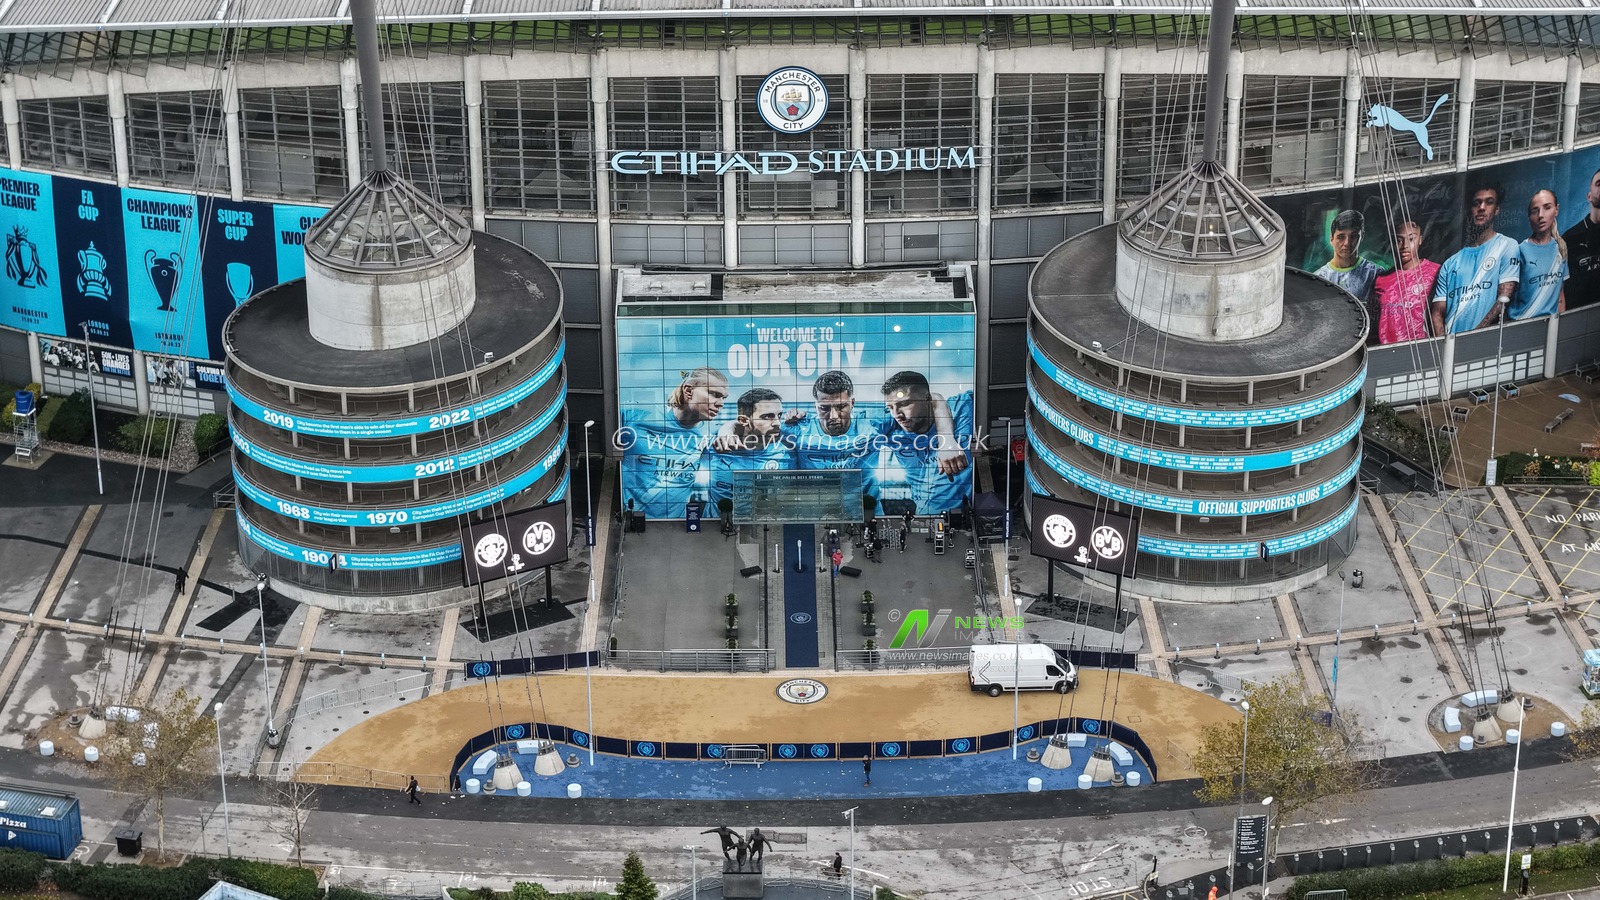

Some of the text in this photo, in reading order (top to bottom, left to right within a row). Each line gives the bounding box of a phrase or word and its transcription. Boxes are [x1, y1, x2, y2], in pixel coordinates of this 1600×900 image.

[765, 72, 820, 92] MANCHESTER
[610, 146, 976, 175] ETIHAD STADIUM
[0, 177, 40, 196] REMIER
[1, 192, 36, 212] LEAGUE
[82, 189, 94, 205] FA
[78, 204, 98, 221] CUP
[126, 198, 192, 218] CHAMPIONS
[218, 208, 254, 226] SUPER
[141, 216, 182, 233] LEAGUE
[225, 225, 248, 241] CUP
[1528, 272, 1563, 285] ETIHAD
[1448, 281, 1492, 298] ETIHAD
[88, 320, 109, 331] LONDON
[757, 327, 834, 343] WELCOME TO
[102, 359, 130, 370] CHANGED
[728, 342, 865, 378] OUR CITY
[263, 410, 294, 428] 2019
[429, 409, 470, 429] 2022
[1070, 423, 1094, 444] CLUBS
[414, 458, 455, 476] 2012
[653, 470, 694, 480] AIRWAYS
[1199, 487, 1320, 514] OFFICIAL SUPPORTERS CLUBS
[277, 501, 310, 519] 1968
[367, 512, 408, 524] 1970
[1545, 514, 1566, 524] NO
[527, 524, 552, 548] BVB
[1096, 528, 1120, 552] BVB
[1562, 544, 1576, 552] AT
[0, 816, 26, 828] Pizza
[1068, 877, 1112, 896] STOP
